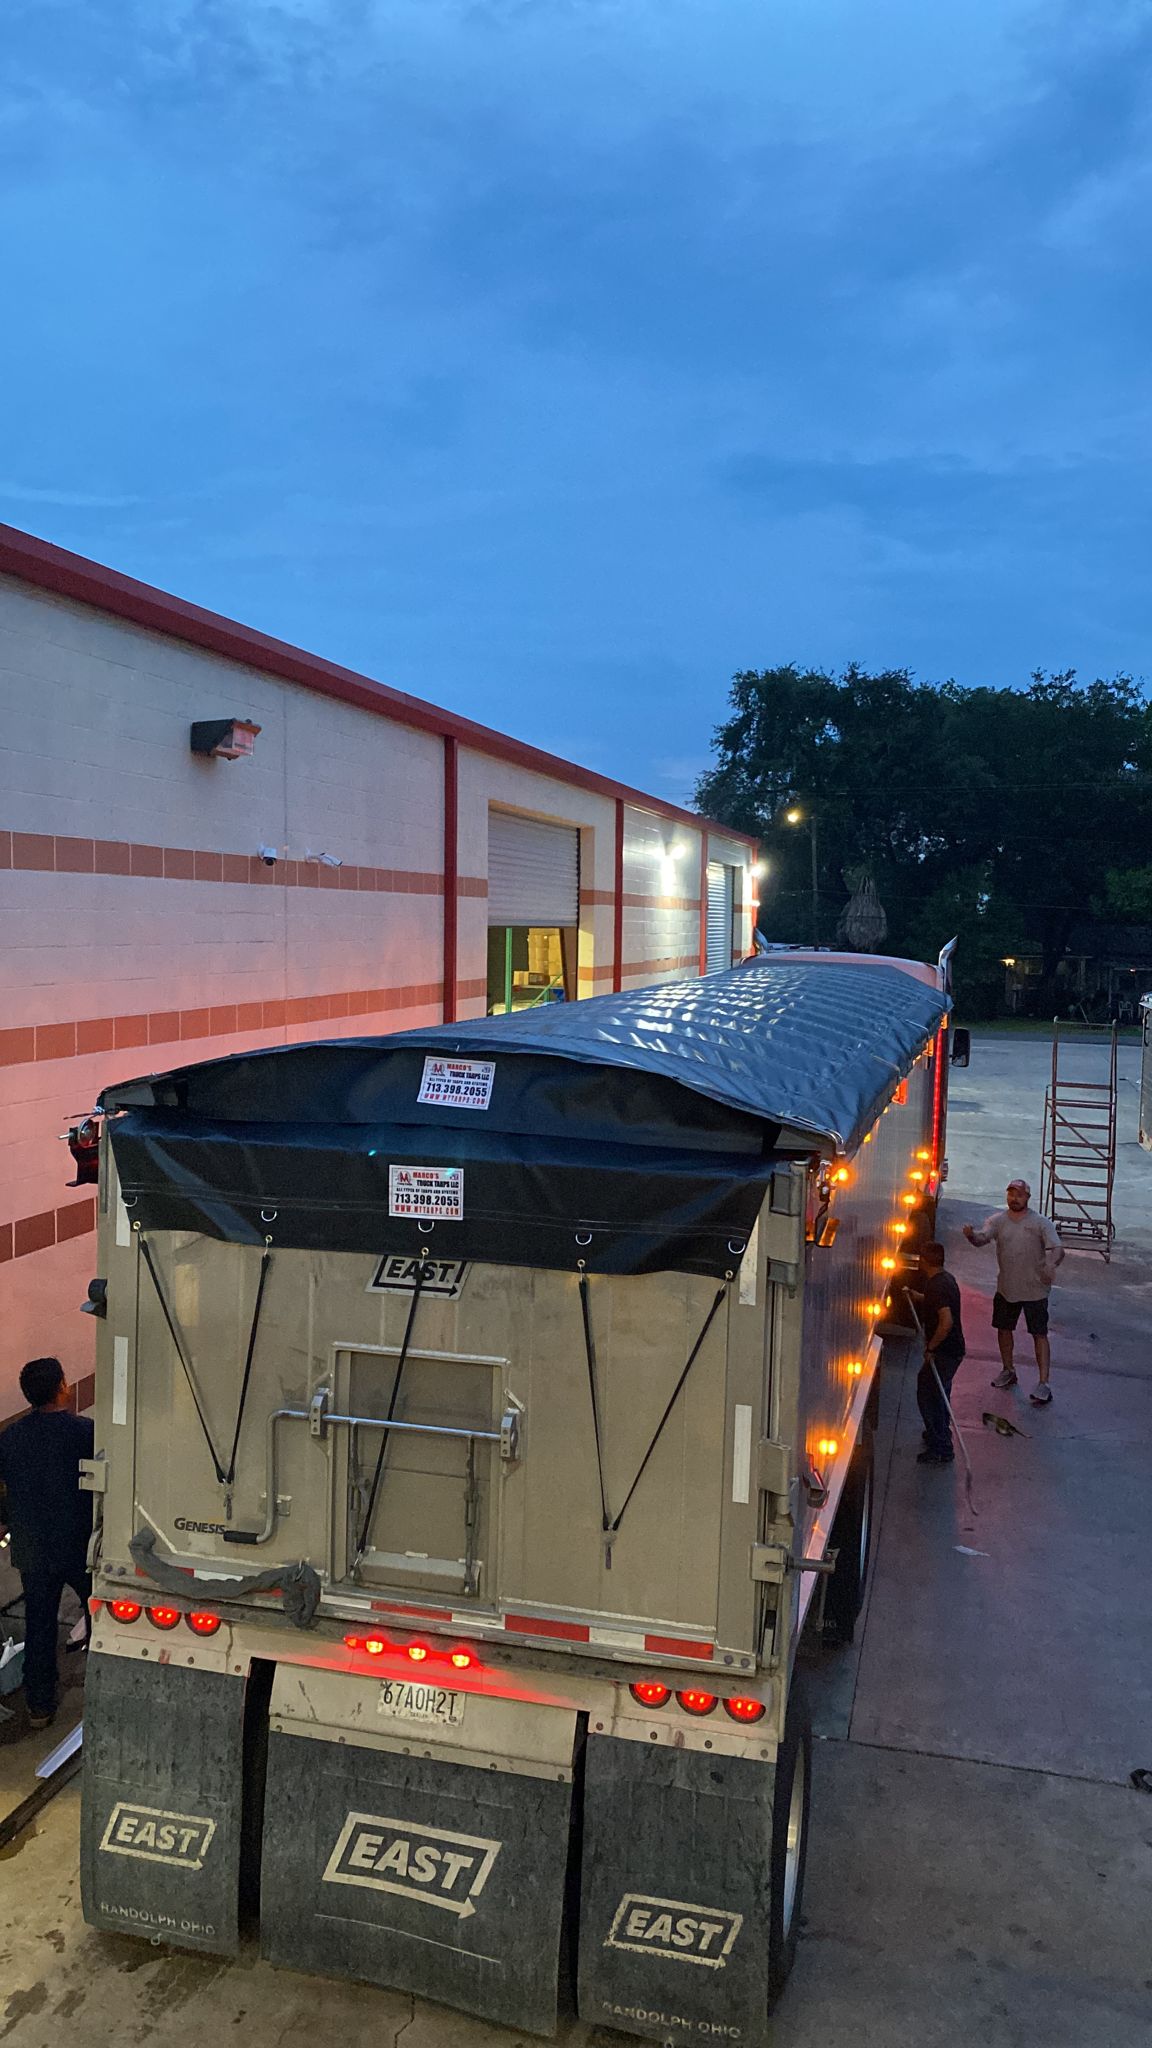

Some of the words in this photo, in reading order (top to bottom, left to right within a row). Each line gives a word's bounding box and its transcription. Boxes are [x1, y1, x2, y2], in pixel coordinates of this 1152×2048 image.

[447, 1063, 472, 1071] MARCO'S
[449, 1070, 465, 1078] TRUCK
[426, 1082, 487, 1097] 713.398.2055
[413, 1171, 439, 1179] MARCO'S
[395, 1193, 459, 1207] 713.398.2055
[386, 1259, 456, 1282] EAST
[174, 1517, 227, 1535] GENESIS
[116, 1816, 200, 1853] EAST
[348, 1832, 474, 1890] EAST
[100, 1901, 176, 1928] RANDOLPH
[180, 1920, 216, 1936] OHIO
[626, 1909, 724, 1950] EAST
[698, 2021, 742, 2039] OHIO
